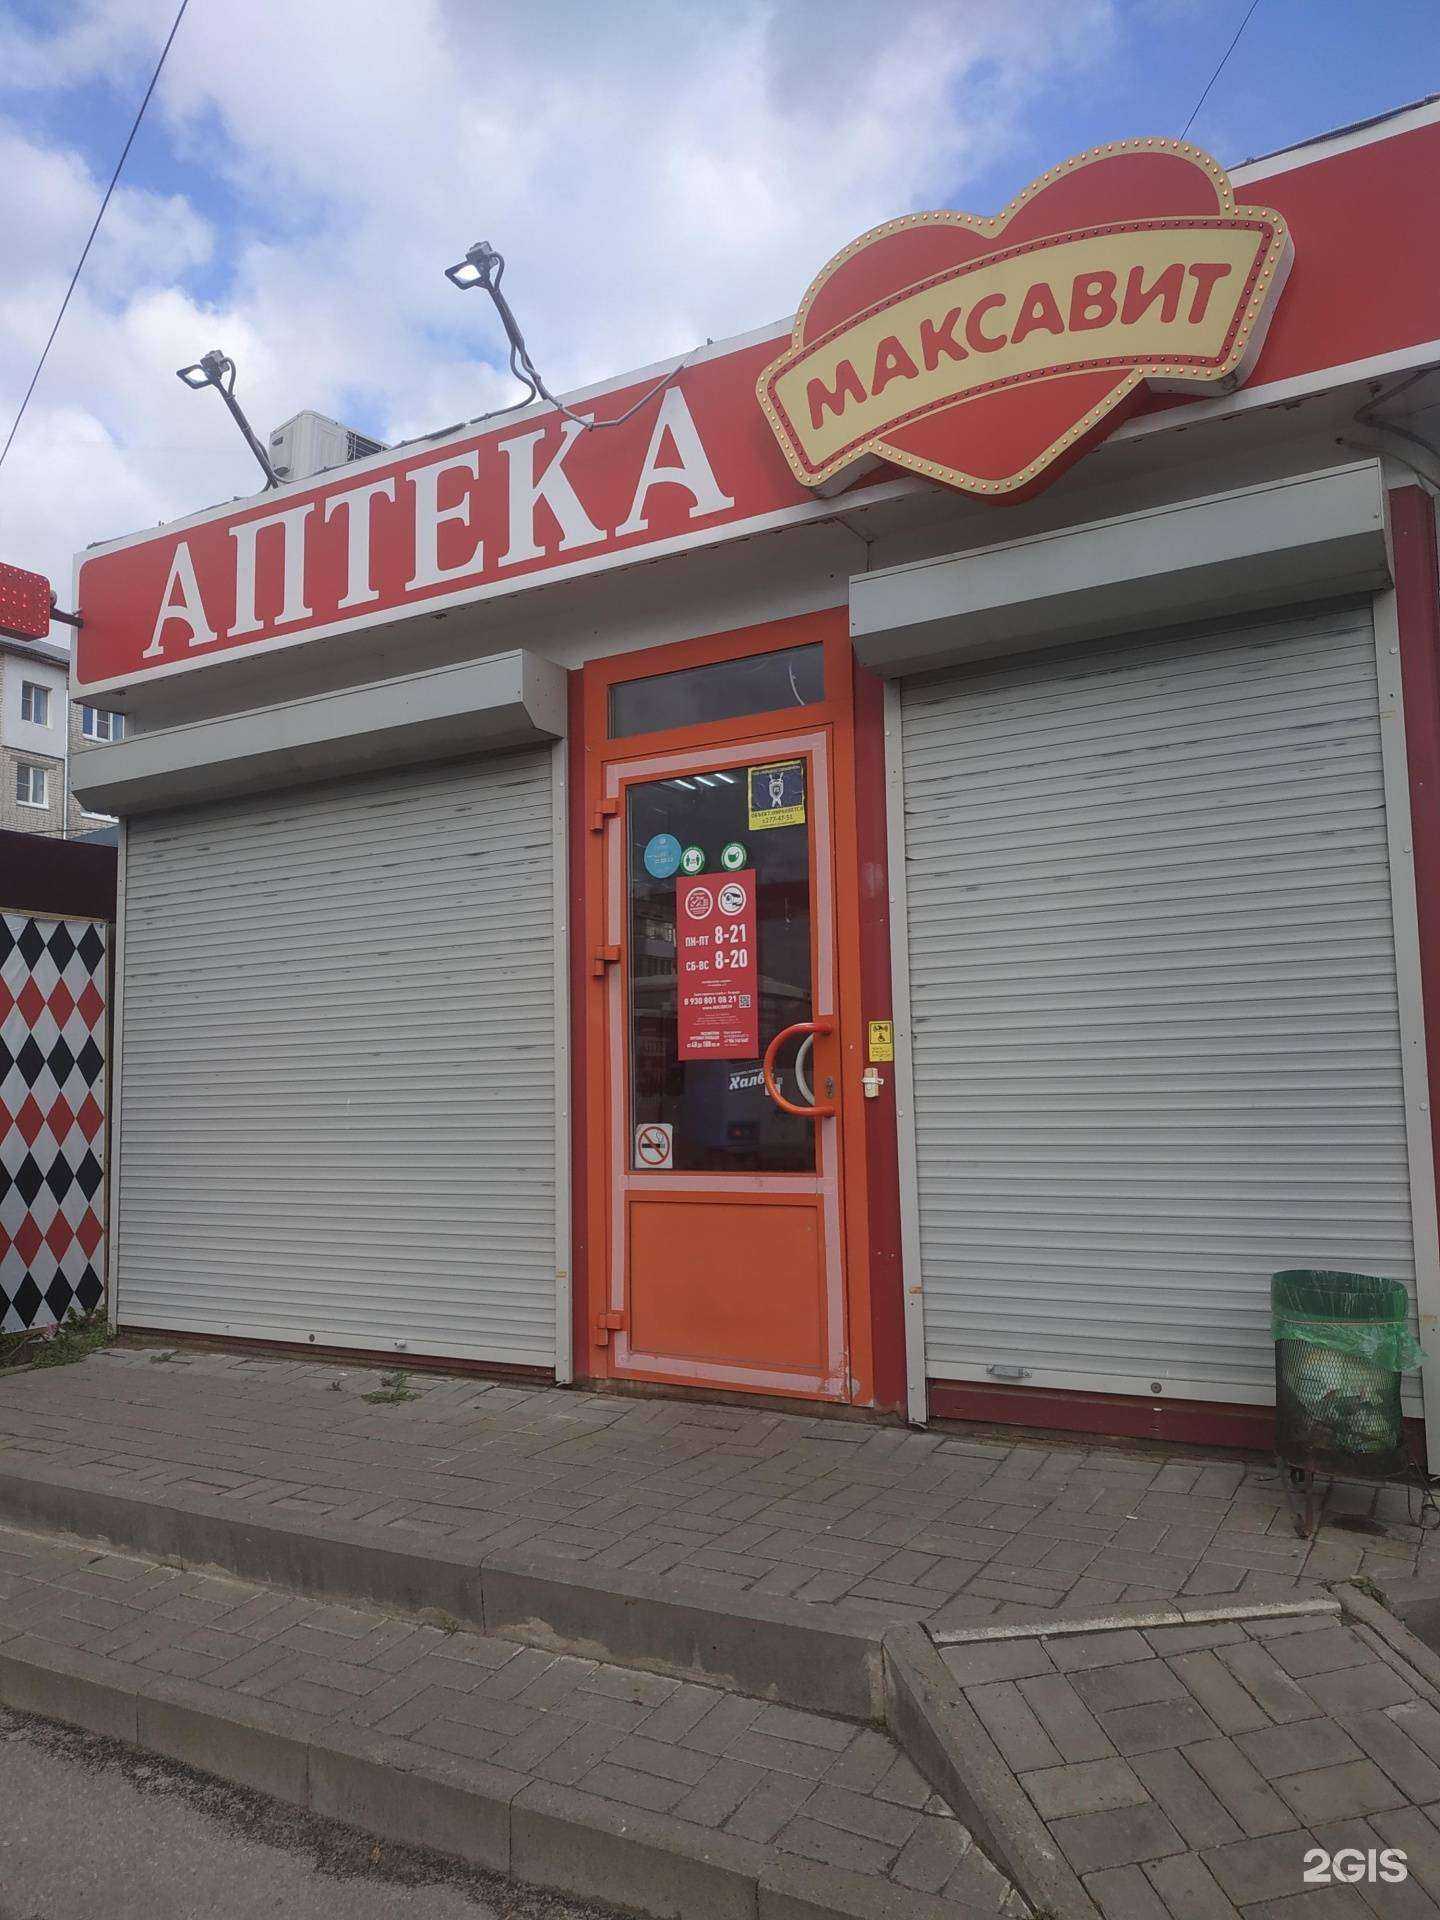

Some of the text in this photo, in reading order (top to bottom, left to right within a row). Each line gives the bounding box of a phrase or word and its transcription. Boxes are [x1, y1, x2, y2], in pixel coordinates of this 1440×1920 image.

[805, 262, 1232, 431] МАКСАВИТ
[142, 386, 735, 659] АПТЕКА
[685, 923, 746, 947] ПН-ПТ 8-21
[686, 949, 748, 971] СБ-ВС 8-20
[728, 995, 737, 1003] 21
[729, 1071, 774, 1090] Халв
